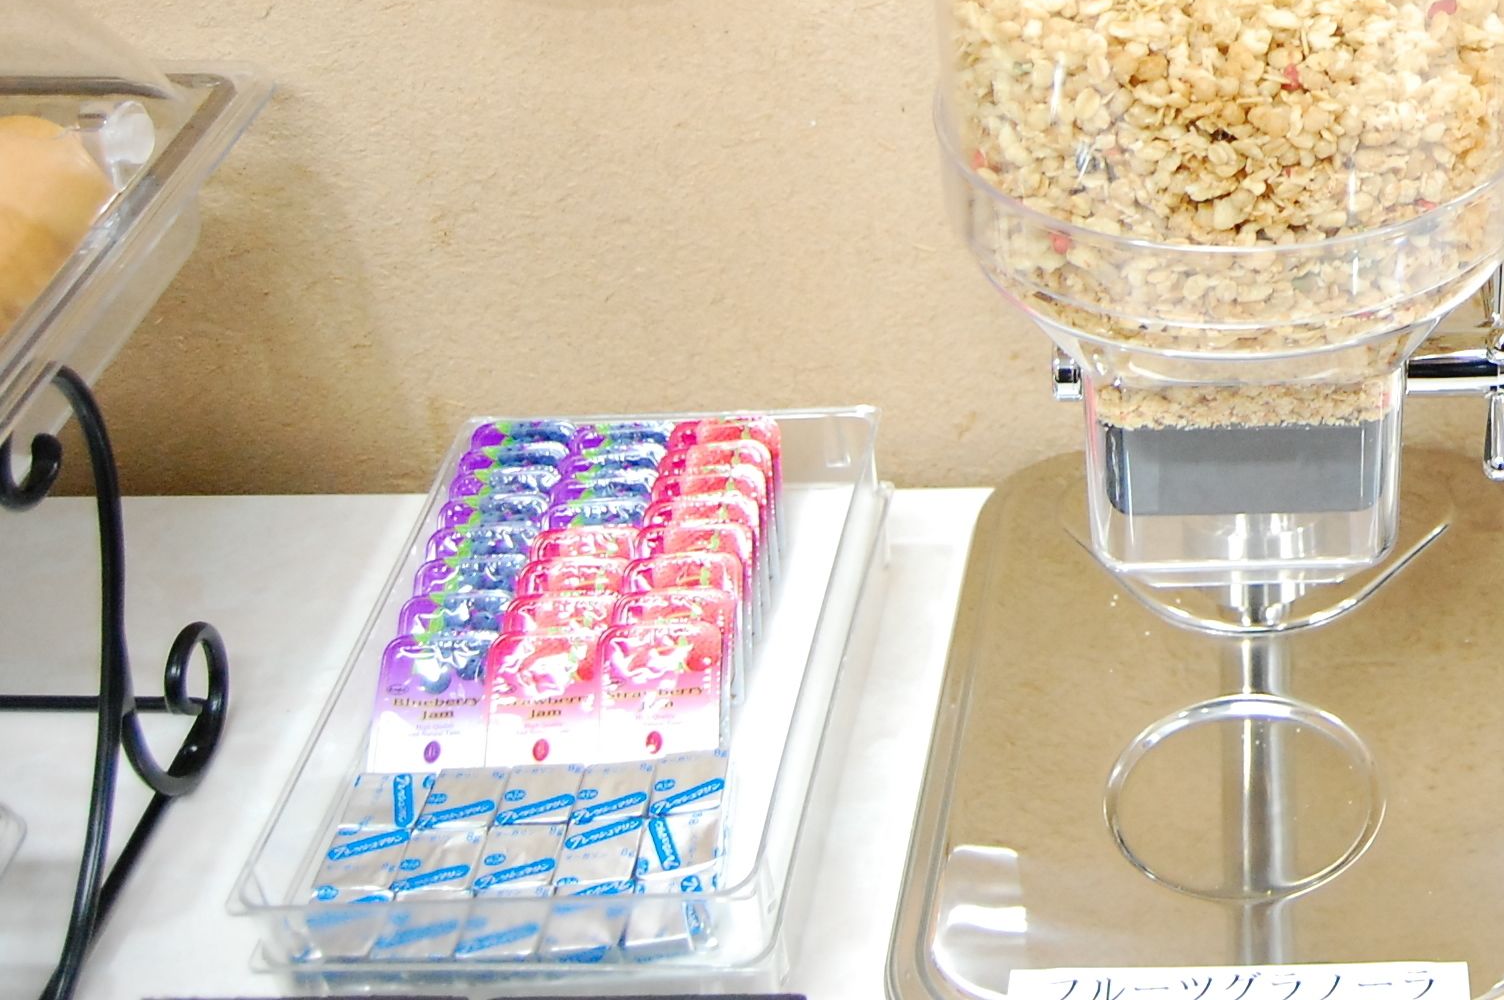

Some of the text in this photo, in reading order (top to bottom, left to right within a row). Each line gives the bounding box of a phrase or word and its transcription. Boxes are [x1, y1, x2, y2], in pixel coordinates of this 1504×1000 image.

[607, 686, 703, 700] Straberry
[422, 710, 454, 721] Jam
[529, 708, 562, 719] Jam
